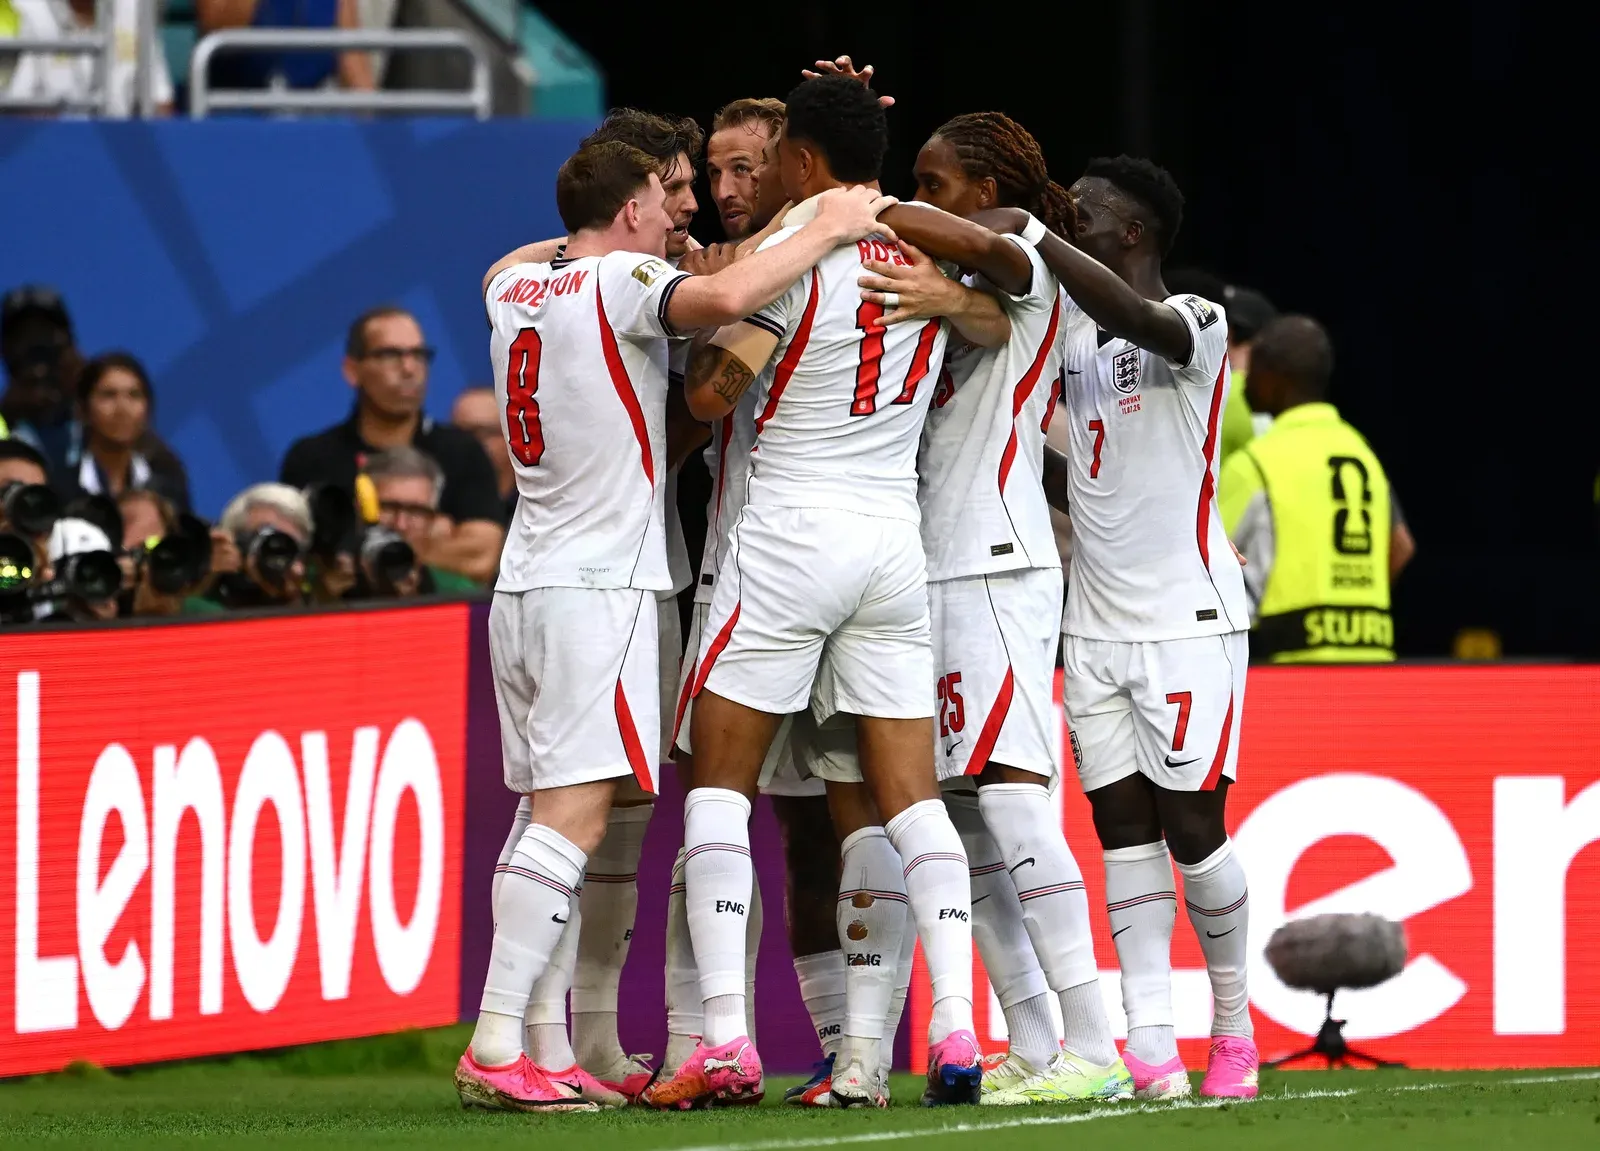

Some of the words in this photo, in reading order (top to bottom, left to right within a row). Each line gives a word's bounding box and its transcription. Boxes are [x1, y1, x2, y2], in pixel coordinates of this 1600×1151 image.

[506, 327, 545, 467] 8
[1118, 394, 1141, 407] NORWAY
[1088, 419, 1105, 478] 7
[936, 671, 966, 738] 25
[1165, 691, 1192, 751] 7
[15, 669, 445, 1034] Lenovo
[715, 900, 743, 916] ENG
[938, 908, 969, 923] ENG
[818, 1023, 842, 1039] ENG
